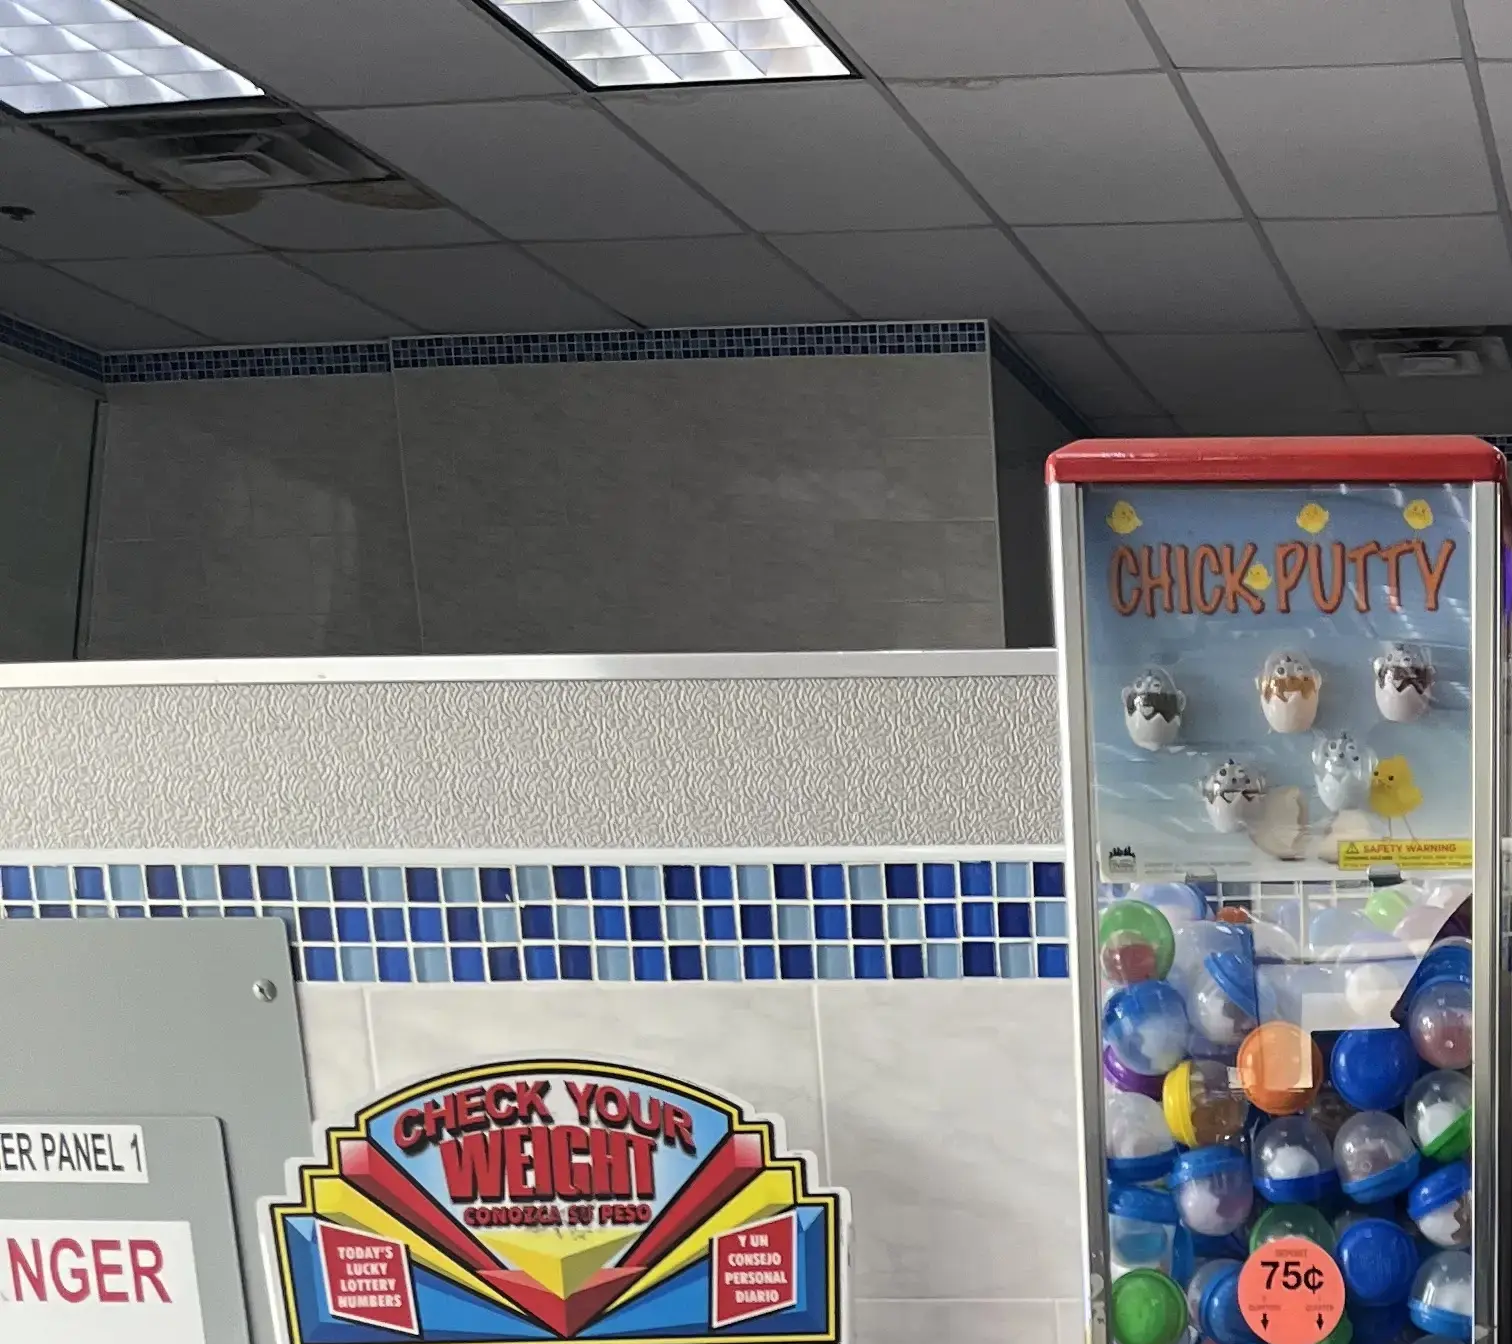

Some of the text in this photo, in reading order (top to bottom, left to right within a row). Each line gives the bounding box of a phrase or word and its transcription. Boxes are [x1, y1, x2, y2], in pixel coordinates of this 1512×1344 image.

[1109, 538, 1456, 617] CHICK PUTTY
[1363, 843, 1458, 854] SAFETY WARNING
[393, 1080, 697, 1156] CHECK YOUR
[40, 1132, 125, 1172] PANEL
[130, 1132, 143, 1173] 1
[439, 1125, 657, 1203] WEIGHT
[600, 1203, 653, 1226] PESO
[737, 1233, 769, 1248] Y UN
[336, 1246, 394, 1260] TODAY'S
[727, 1252, 782, 1267] CONSEJO
[345, 1262, 388, 1276] LUCKY
[724, 1270, 788, 1285] PERSONAL
[1260, 1260, 1324, 1294] 75¢
[339, 1278, 397, 1292] LOTTERY
[336, 1294, 403, 1308] NUMBERS
[735, 1288, 780, 1303] DIARIO
